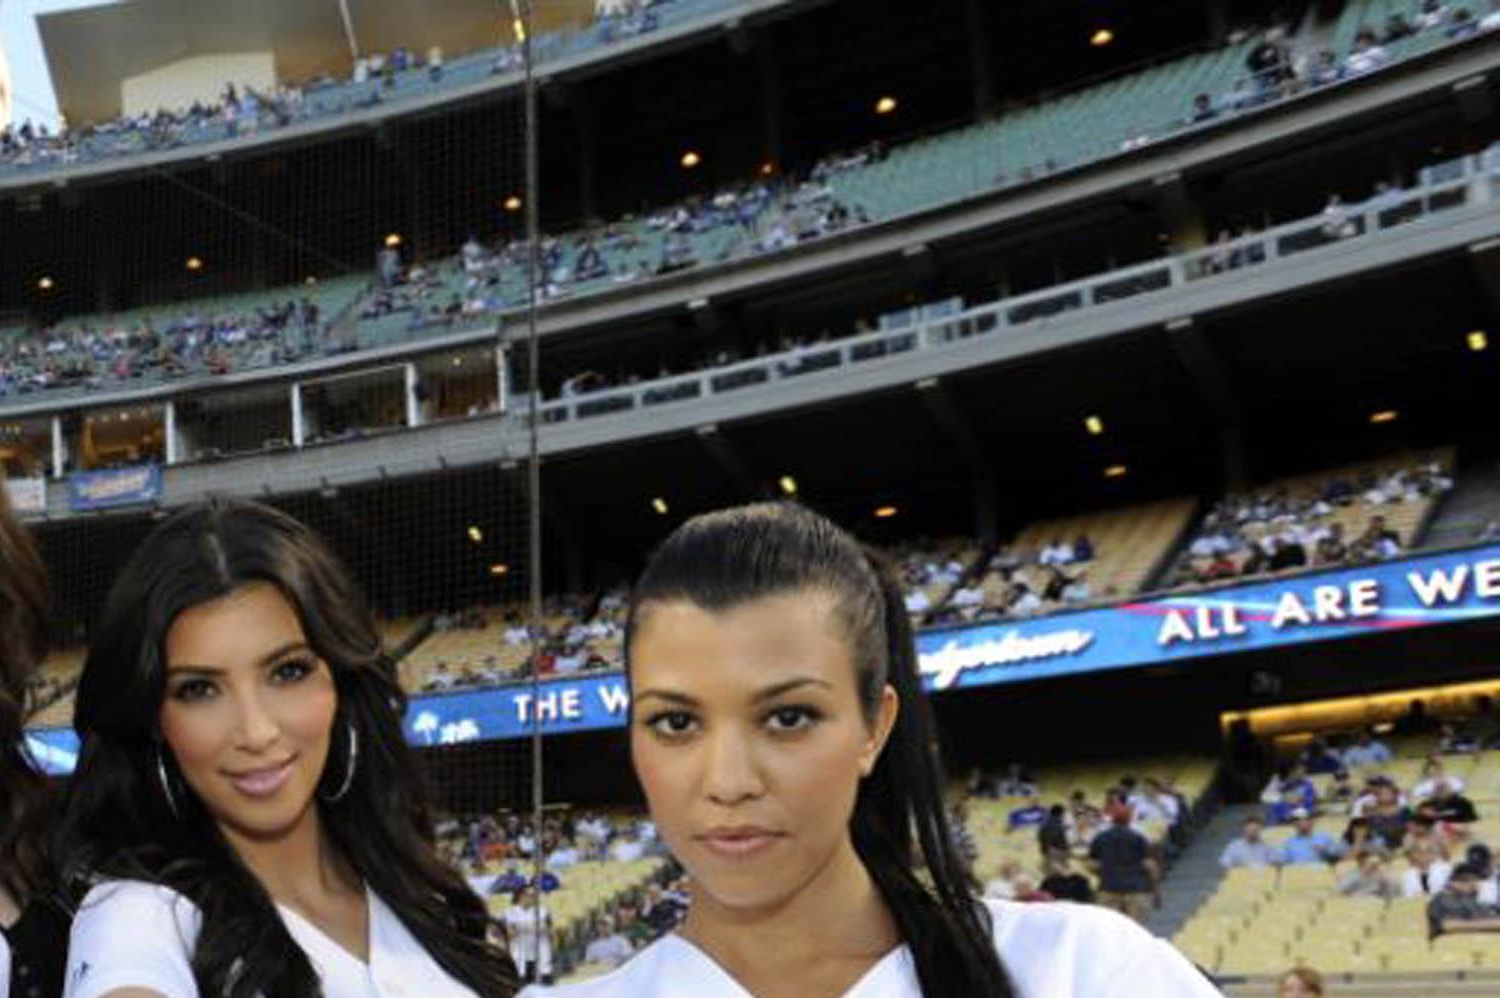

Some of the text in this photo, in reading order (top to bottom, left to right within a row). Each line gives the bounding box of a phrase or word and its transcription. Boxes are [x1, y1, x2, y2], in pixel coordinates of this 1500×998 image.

[1158, 604, 1247, 645] ALL
[1271, 579, 1380, 628] ARE
[513, 689, 582, 721] THE
